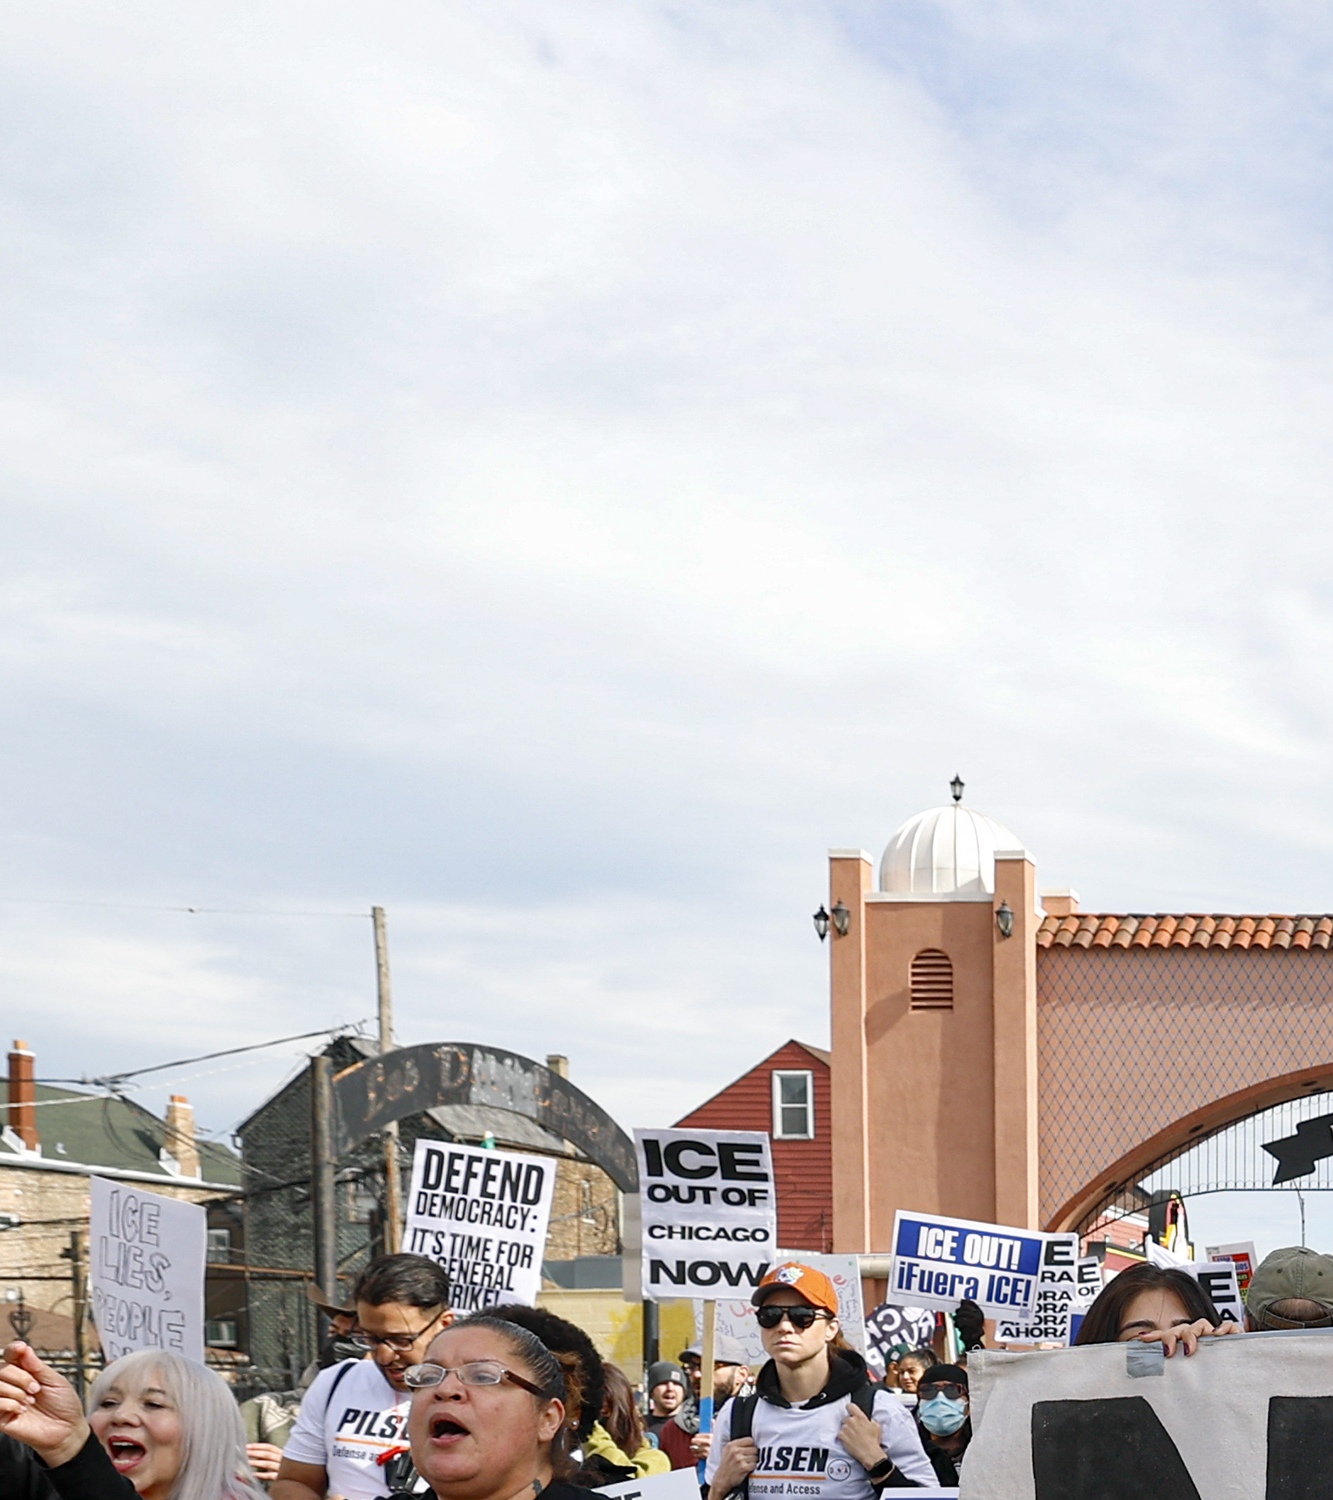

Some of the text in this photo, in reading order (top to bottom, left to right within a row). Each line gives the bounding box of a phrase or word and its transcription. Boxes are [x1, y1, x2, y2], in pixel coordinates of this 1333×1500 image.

[422, 1148, 545, 1206] DEFEND
[641, 1138, 769, 1182] ICE
[415, 1190, 538, 1234] DEMOCRACY:
[647, 1183, 769, 1207] OUT OF
[109, 1189, 161, 1248] ICE
[647, 1225, 770, 1243] CHICAGO
[100, 1235, 171, 1302] LIES,
[410, 1227, 535, 1270] IT'S TIME FOR
[917, 1226, 960, 1262] ICE
[963, 1233, 1022, 1271] OUT!
[649, 1259, 771, 1287] NOW
[986, 1274, 1032, 1308] ICE!
[93, 1286, 186, 1353] PEOPLE
[336, 1408, 410, 1441] PILS
[757, 1446, 829, 1473] ILSEN
[769, 1483, 784, 1494] and
[786, 1483, 821, 1495] Access
